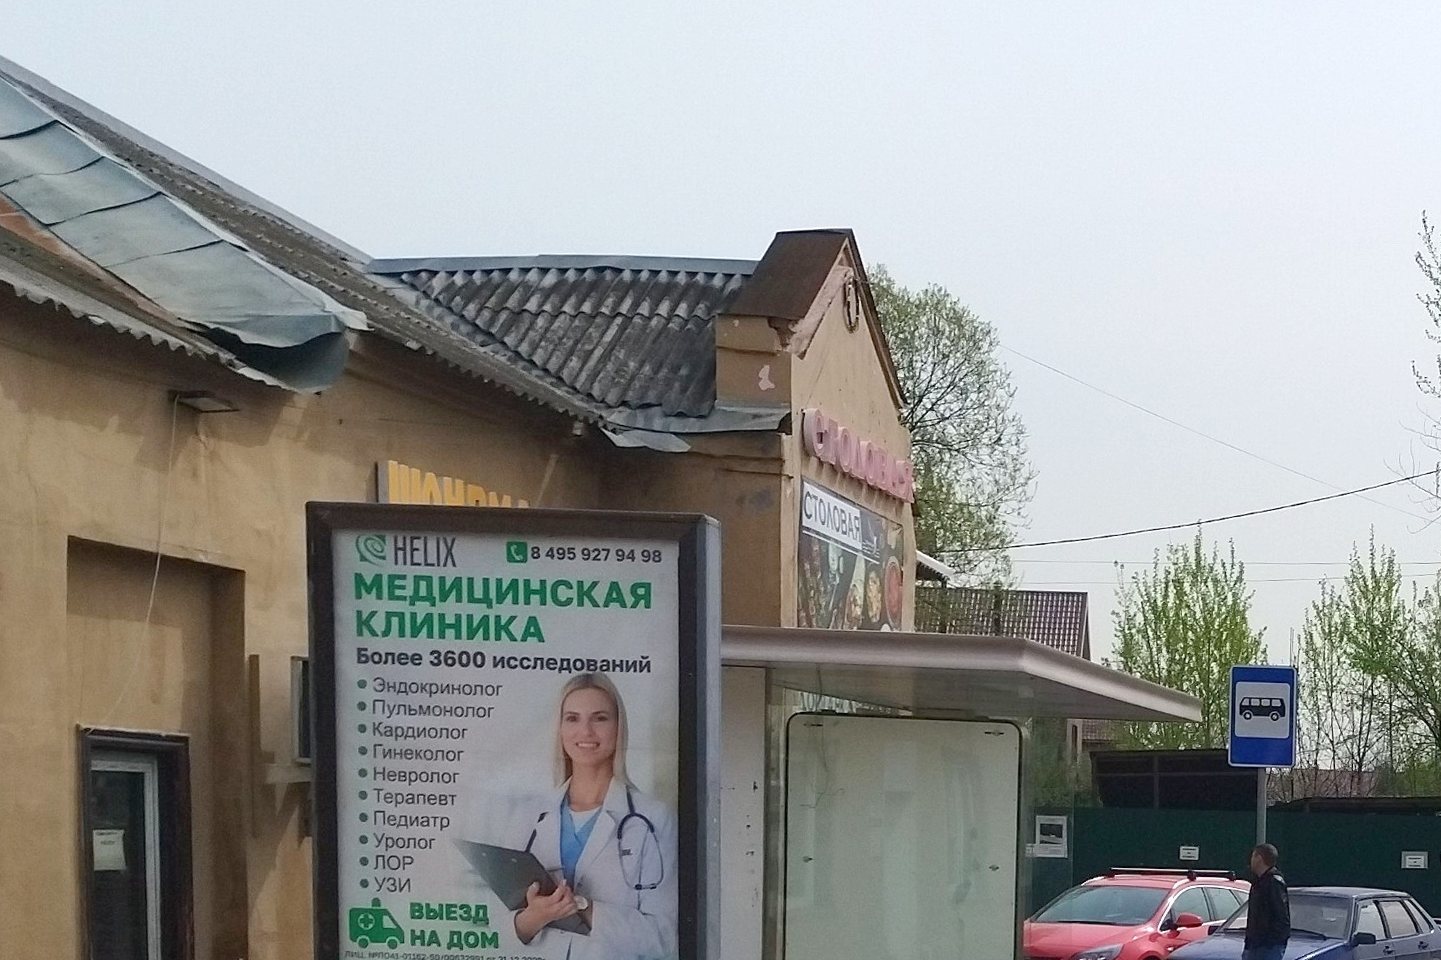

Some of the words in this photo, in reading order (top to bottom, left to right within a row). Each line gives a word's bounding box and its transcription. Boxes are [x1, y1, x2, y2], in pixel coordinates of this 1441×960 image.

[804, 408, 914, 503] СТОЛОВАЯ
[804, 491, 861, 542] СТОЛОВАЯ
[393, 536, 457, 567] HELIX
[531, 546, 541, 559] 8
[545, 547, 577, 560] 495
[581, 548, 610, 561] 927
[615, 549, 636, 562] 94
[641, 550, 662, 563] 98
[354, 572, 652, 609] МЕДИЦИНСКАЯ
[355, 610, 545, 642] КЛИНИКА
[356, 648, 423, 666] Более
[429, 650, 486, 669] 3600
[492, 654, 651, 674] исследований
[373, 677, 503, 697] Эндокринолог
[372, 700, 495, 718] Пульмонолог
[372, 722, 468, 741] Кардиолог
[373, 744, 465, 761] Гинеколог
[373, 767, 460, 785] Невролог
[373, 788, 457, 806] Терапевт
[373, 811, 450, 830] Педиатр
[373, 833, 435, 851] Уролог
[373, 855, 414, 870] ЛОР
[373, 878, 411, 892] УЗИ
[409, 902, 489, 925] ВЫЕЗД
[410, 929, 441, 947] НА
[447, 930, 499, 950] ДОМ
